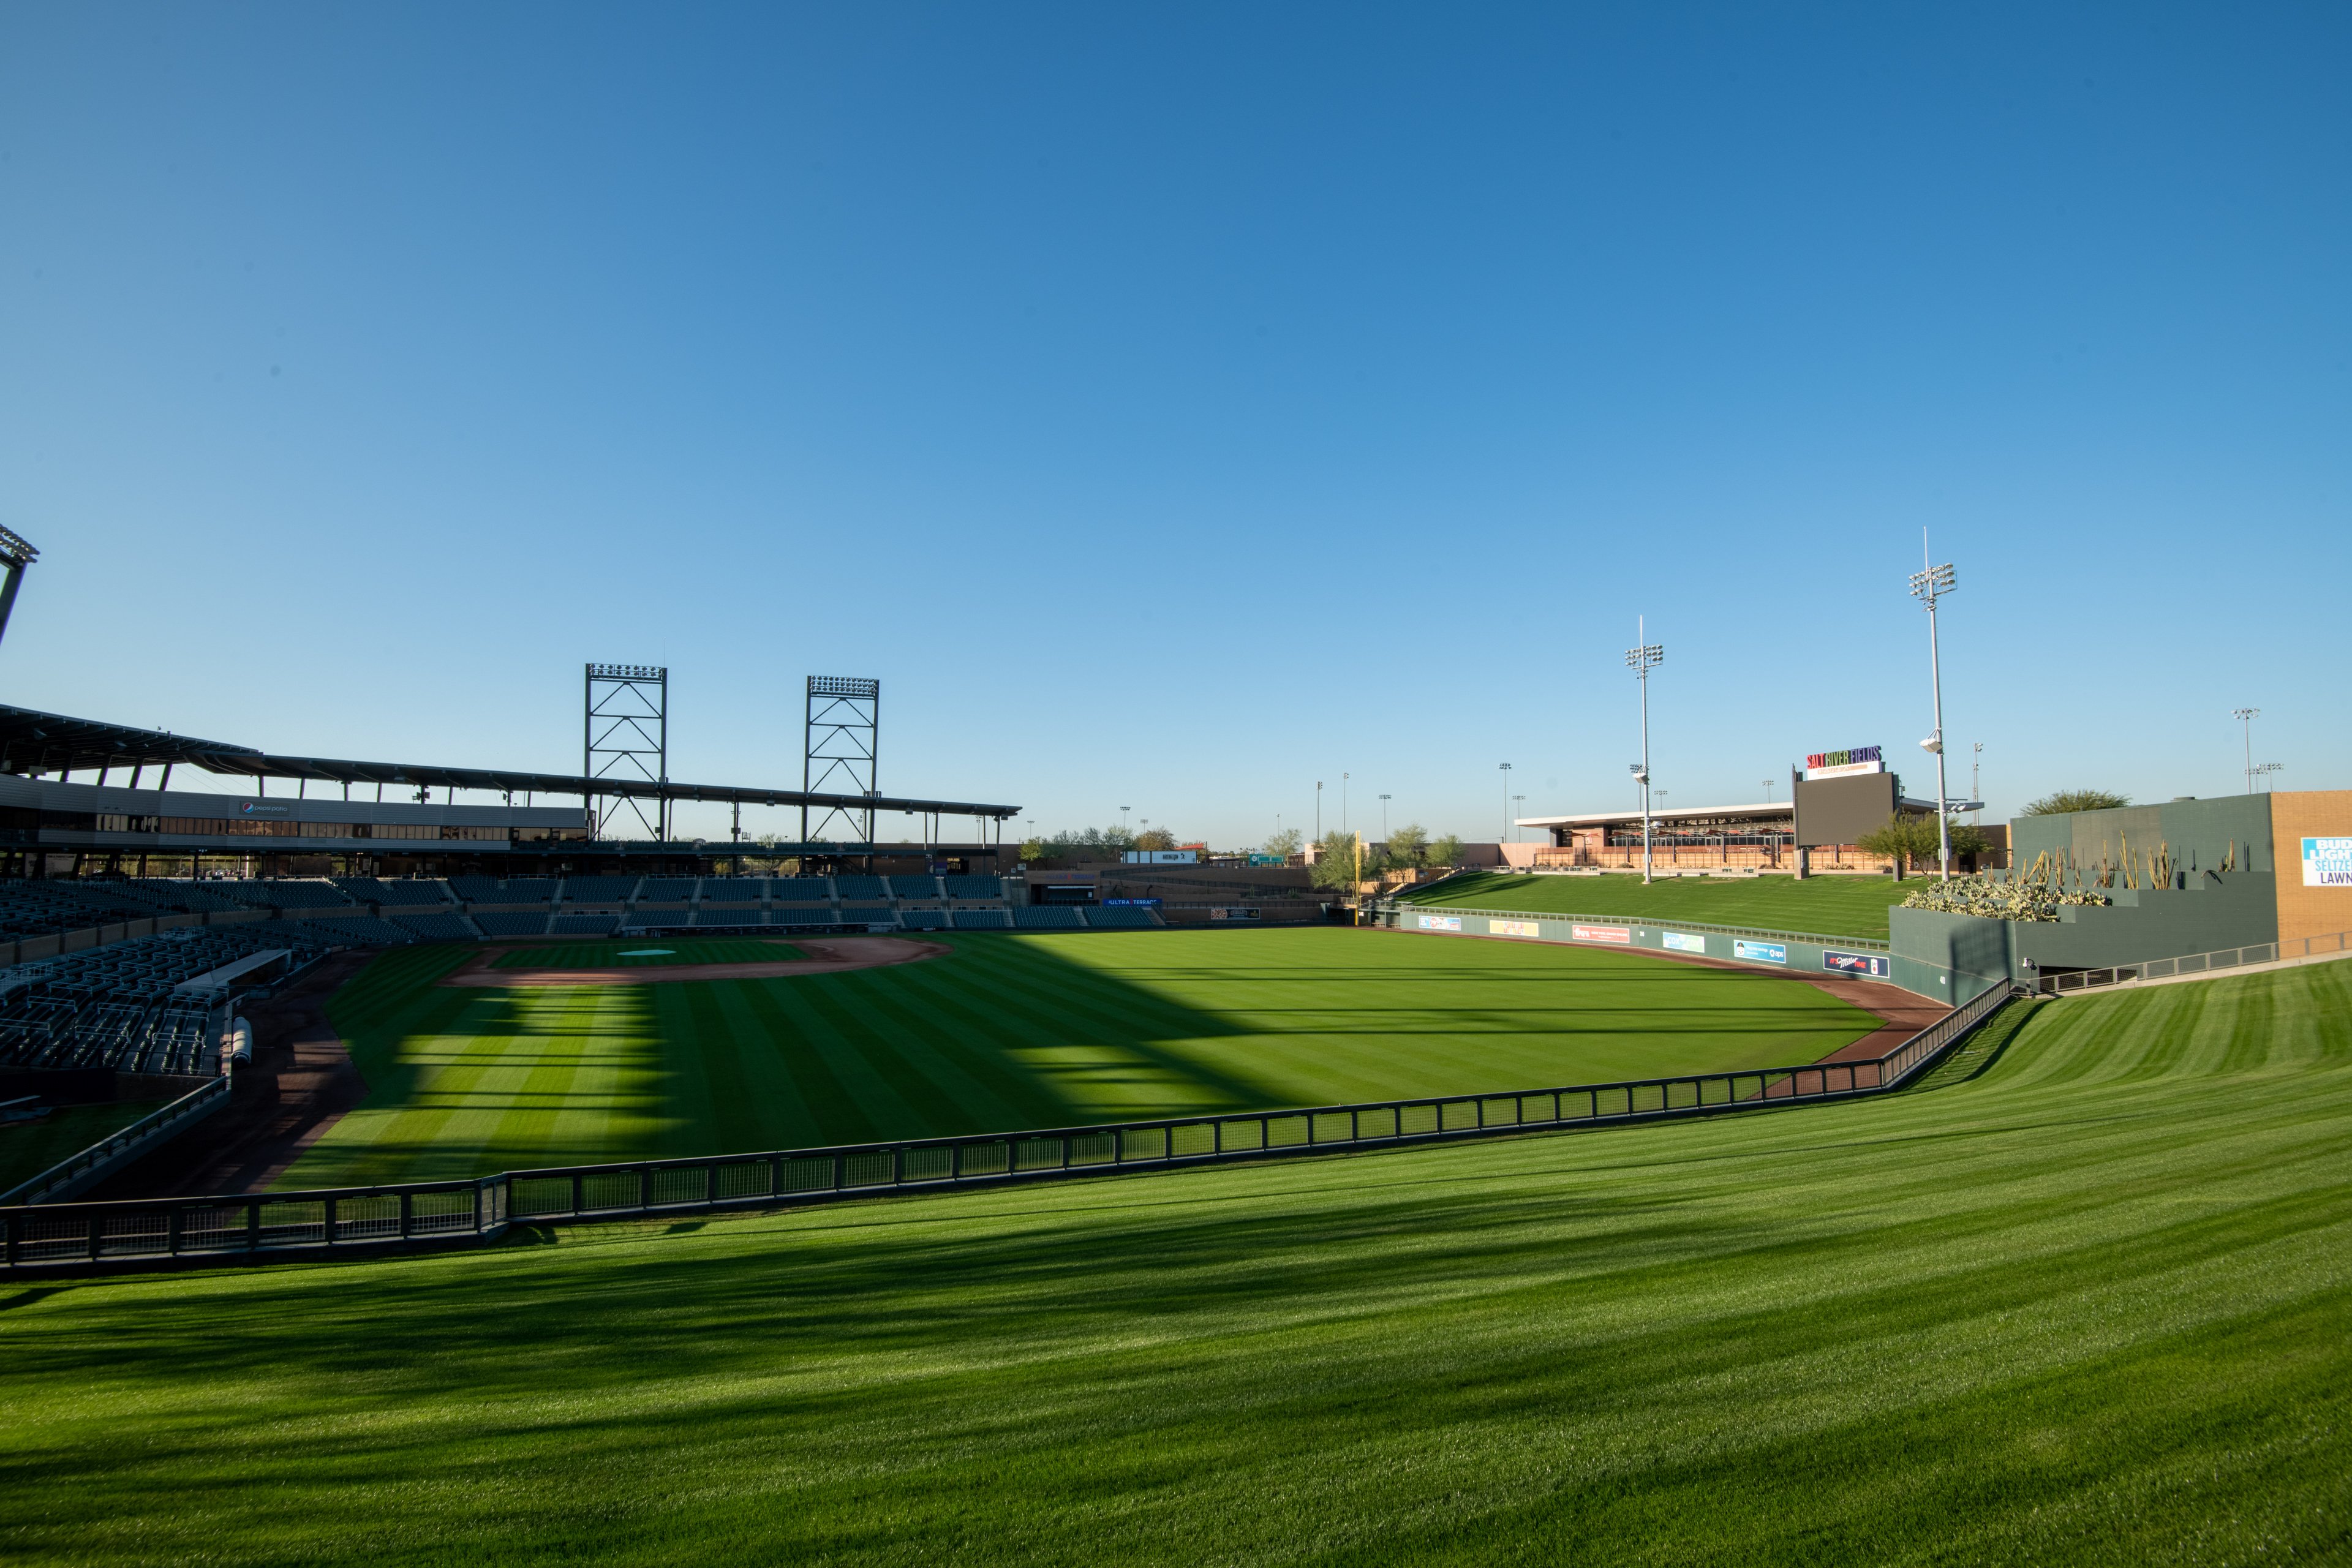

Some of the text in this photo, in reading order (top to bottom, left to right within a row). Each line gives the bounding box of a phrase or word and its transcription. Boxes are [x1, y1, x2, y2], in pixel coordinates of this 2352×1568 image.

[1807, 745, 1882, 769] SALT RIVER FIELDS
[2316, 839, 2352, 850] BUD
[2310, 850, 2352, 859] LIGH
[2315, 860, 2352, 871] SELTZE
[2320, 872, 2352, 884] LAWN
[1667, 937, 1680, 945] COX
[1837, 957, 1858, 968] Miller
